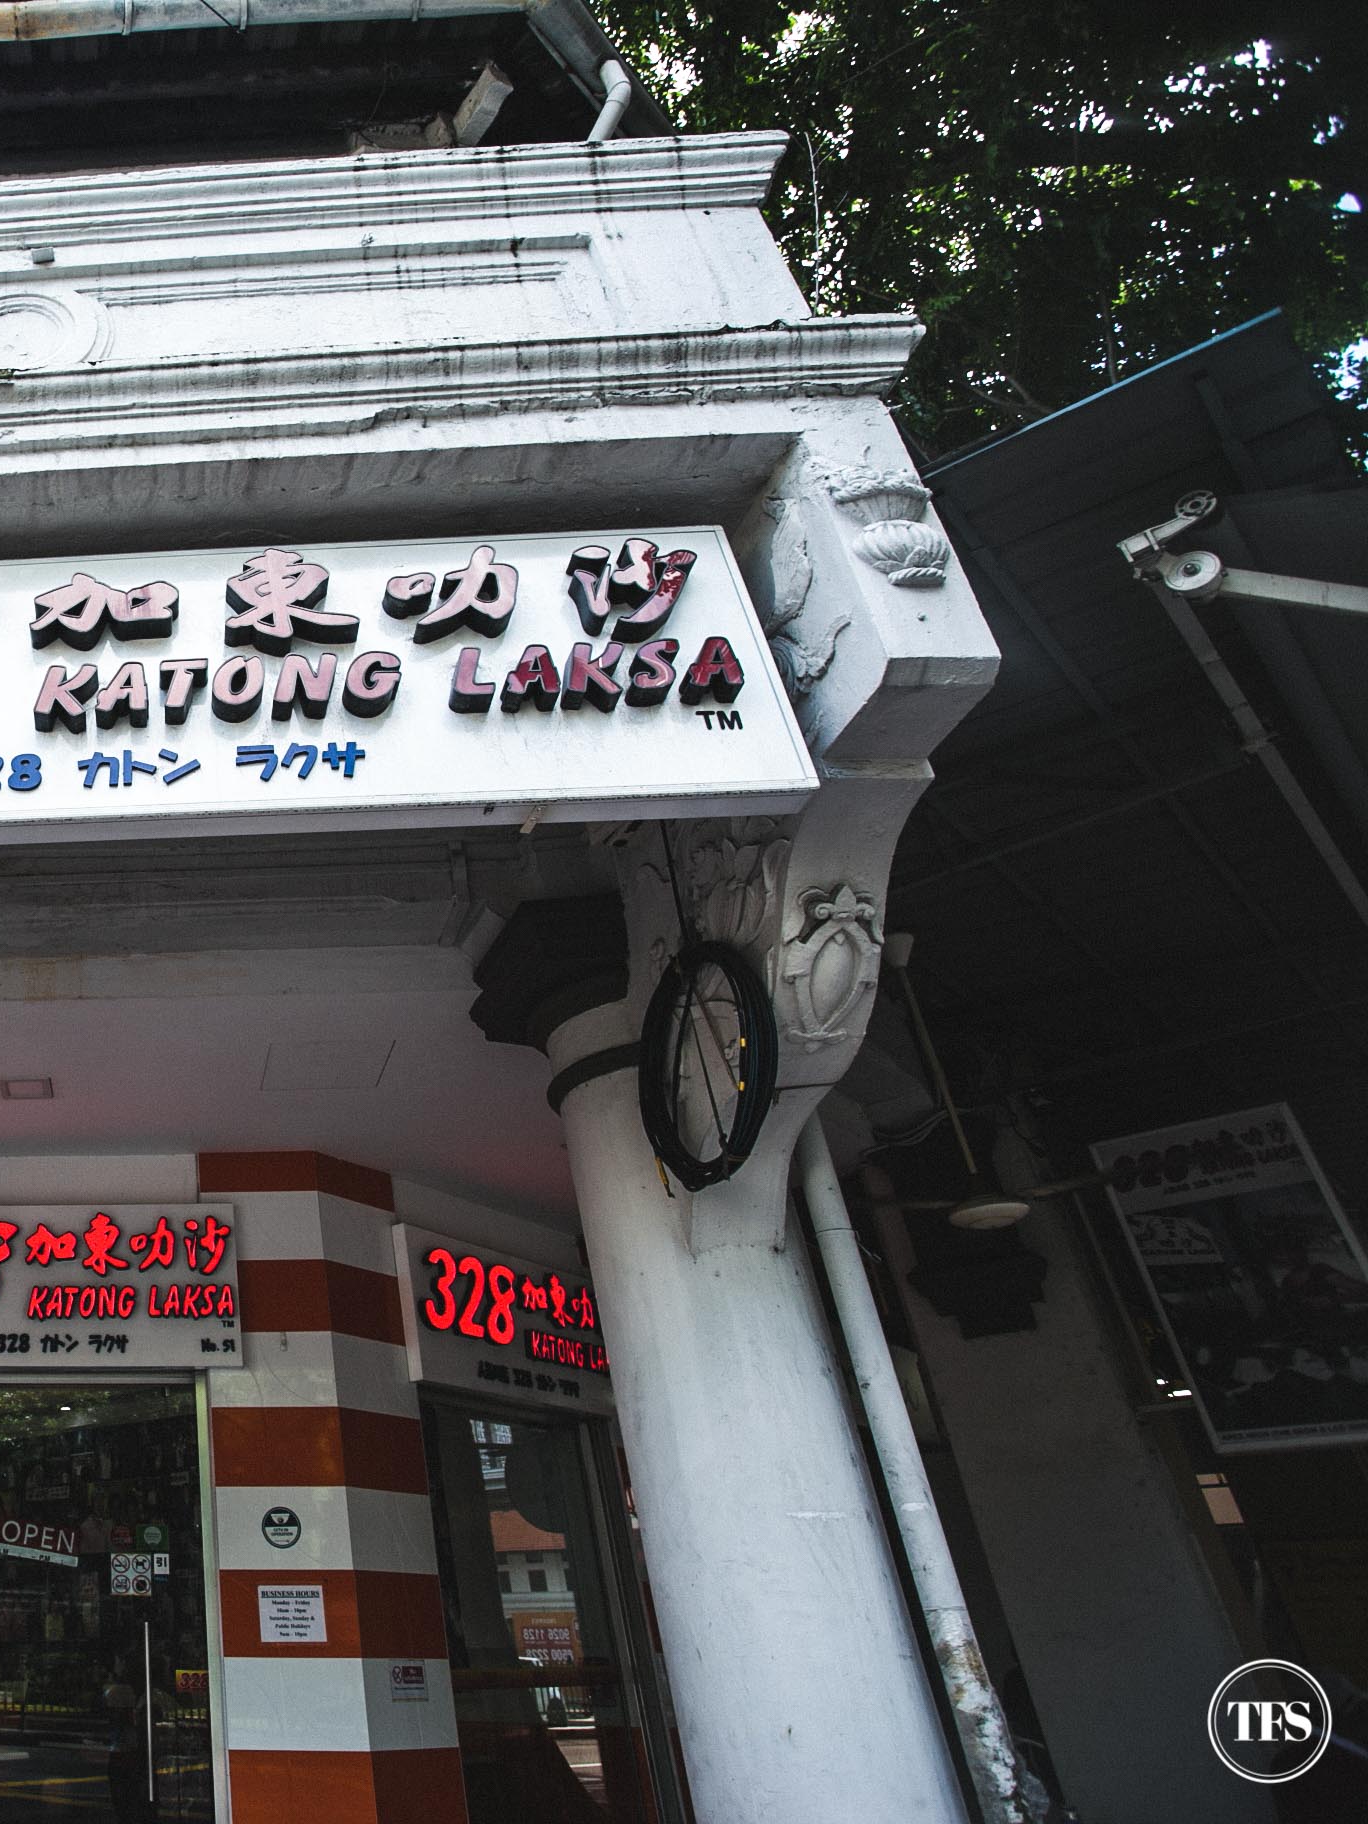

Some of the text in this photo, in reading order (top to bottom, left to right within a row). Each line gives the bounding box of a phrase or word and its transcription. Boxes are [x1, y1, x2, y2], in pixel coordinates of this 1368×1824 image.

[35, 636, 743, 733] KATONG LAKSA
[78, 748, 201, 789] カトン
[236, 740, 366, 781] ラクサ
[27, 1284, 234, 1320] KATONG LAKSA
[425, 1248, 516, 1345] 328
[531, 1330, 610, 1371] KATONG LA
[2, 1520, 75, 1552] OPEN
[261, 1590, 320, 1598] BUSINESS HOURS
